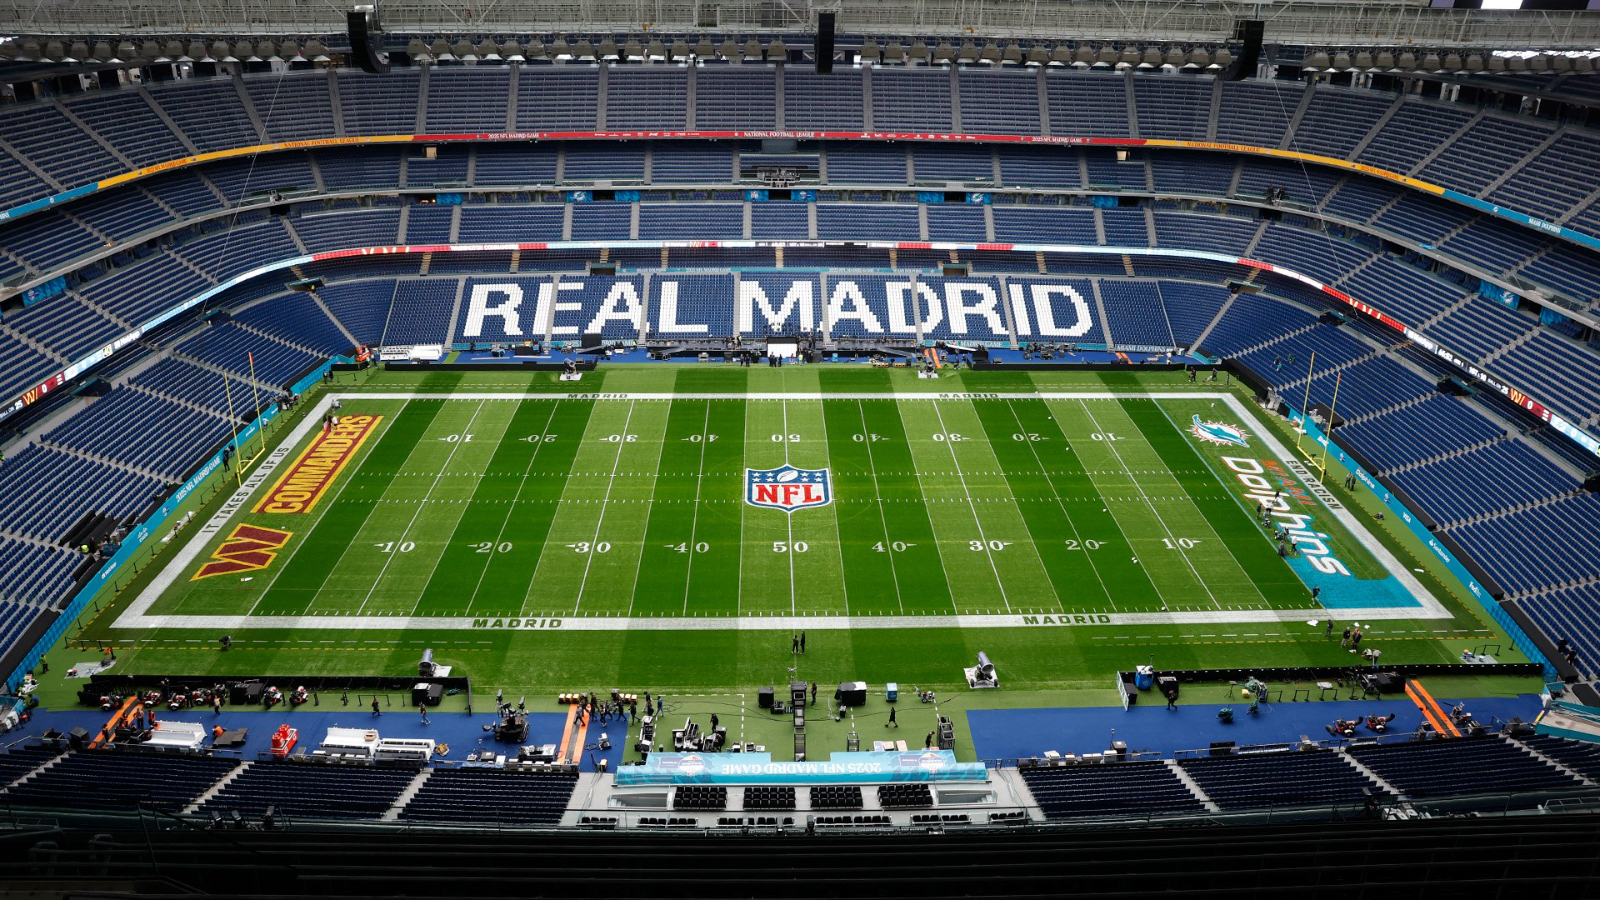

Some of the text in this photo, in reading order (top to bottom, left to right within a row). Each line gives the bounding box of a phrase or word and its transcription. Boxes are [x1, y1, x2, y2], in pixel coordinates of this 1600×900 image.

[463, 281, 1093, 336] REAL MADRID
[1117, 344, 1166, 353] MIAMI DOLPHINS
[41, 383, 48, 393] 0
[15, 399, 23, 410] 25
[1527, 400, 1533, 410] 0
[446, 434, 475, 443] 10
[527, 434, 559, 443] 20
[608, 434, 639, 443] 30
[690, 434, 719, 443] 40
[771, 434, 801, 443] 50
[852, 434, 883, 443] 40
[932, 433, 963, 443] 30
[1012, 433, 1042, 443] 20
[1090, 433, 1119, 443] 10
[263, 415, 373, 513] COMMANDERS
[1286, 460, 1308, 475] END
[193, 466, 210, 486] MADRID
[208, 455, 221, 471] GAME
[201, 447, 289, 533] IT TAKES ALL OF US
[755, 484, 822, 505] NFL
[1219, 456, 1352, 577] Dolphins
[380, 541, 416, 553] 10
[475, 541, 513, 553] 20
[574, 541, 612, 553] 30
[673, 542, 710, 553] 40
[772, 542, 808, 553] 50
[871, 541, 907, 553] 40
[969, 540, 1004, 552] 30
[1065, 540, 1101, 552] 20
[1161, 537, 1195, 550] 10
[472, 618, 562, 628] MADRID
[1022, 614, 1111, 625] MADRID
[721, 762, 882, 775] 2025 NFL MADRID GAME
